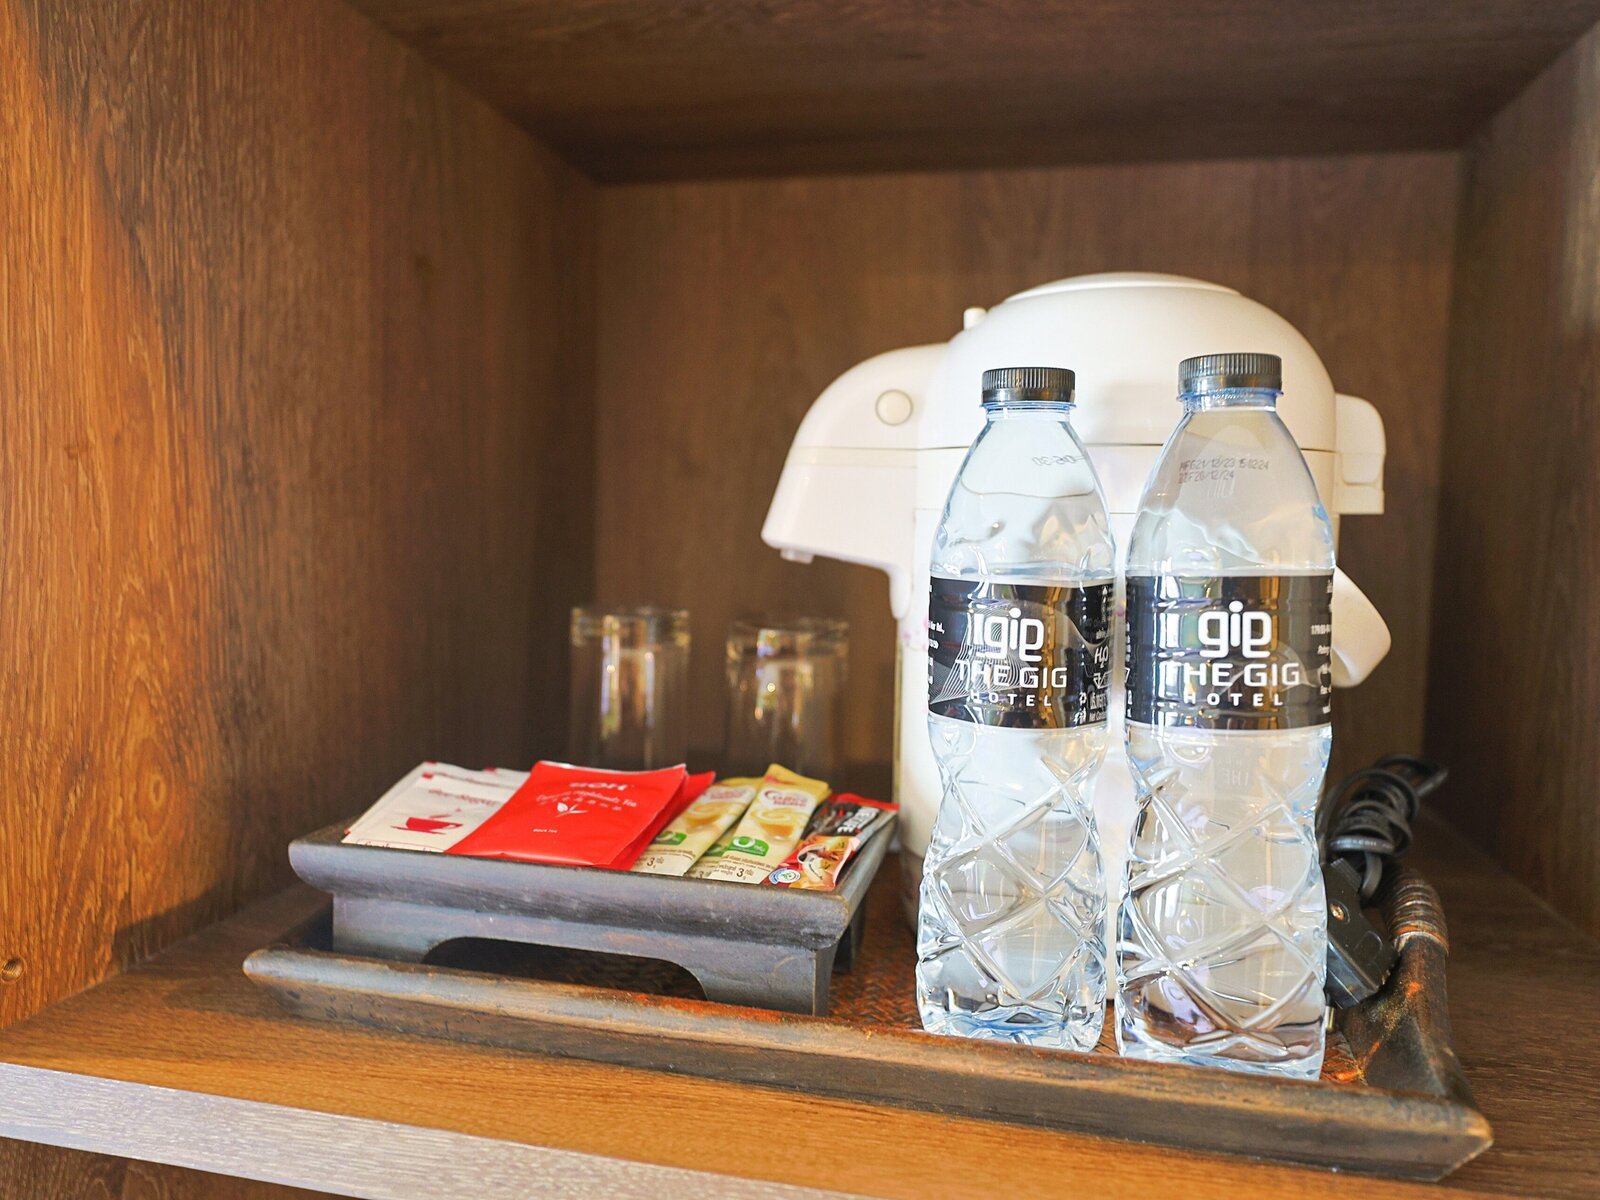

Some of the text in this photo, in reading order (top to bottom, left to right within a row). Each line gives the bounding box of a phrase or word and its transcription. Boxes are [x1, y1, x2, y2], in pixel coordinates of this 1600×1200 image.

[1019, 667, 1068, 689] GIG
[1243, 662, 1301, 687] GIG
[970, 690, 1052, 707] HOTEL
[1183, 693, 1284, 707] HOTEL
[736, 867, 745, 878] 3
